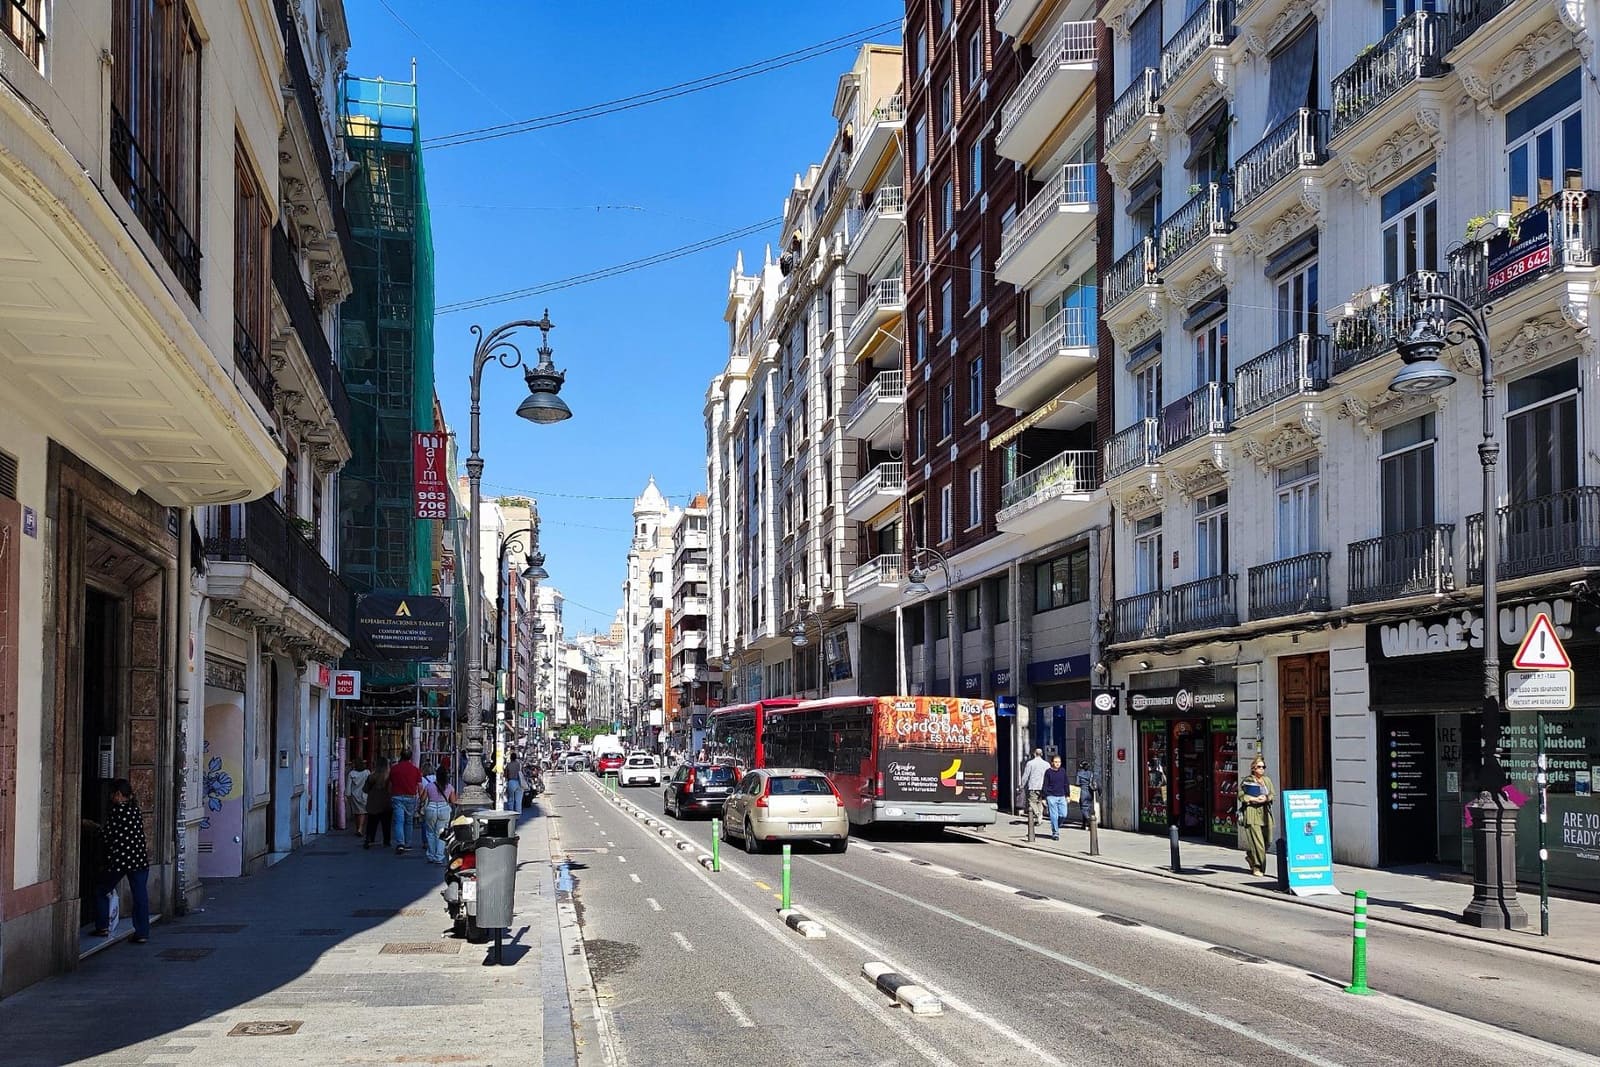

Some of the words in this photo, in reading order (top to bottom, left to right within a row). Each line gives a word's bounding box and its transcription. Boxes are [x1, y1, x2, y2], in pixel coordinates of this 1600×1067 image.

[1489, 272, 1505, 289] 963
[1507, 261, 1525, 278] 528
[1527, 250, 1548, 269] 642
[418, 491, 446, 500] 963
[418, 501, 446, 510] 706
[418, 510, 446, 518] 028
[1380, 610, 1484, 657] What's
[1054, 661, 1071, 676] BBVA
[931, 705, 944, 713] 35
[961, 704, 980, 714] 7063
[1544, 722, 1563, 735] the
[1544, 758, 1587, 769] iferente
[1563, 812, 1584, 828] ARE
